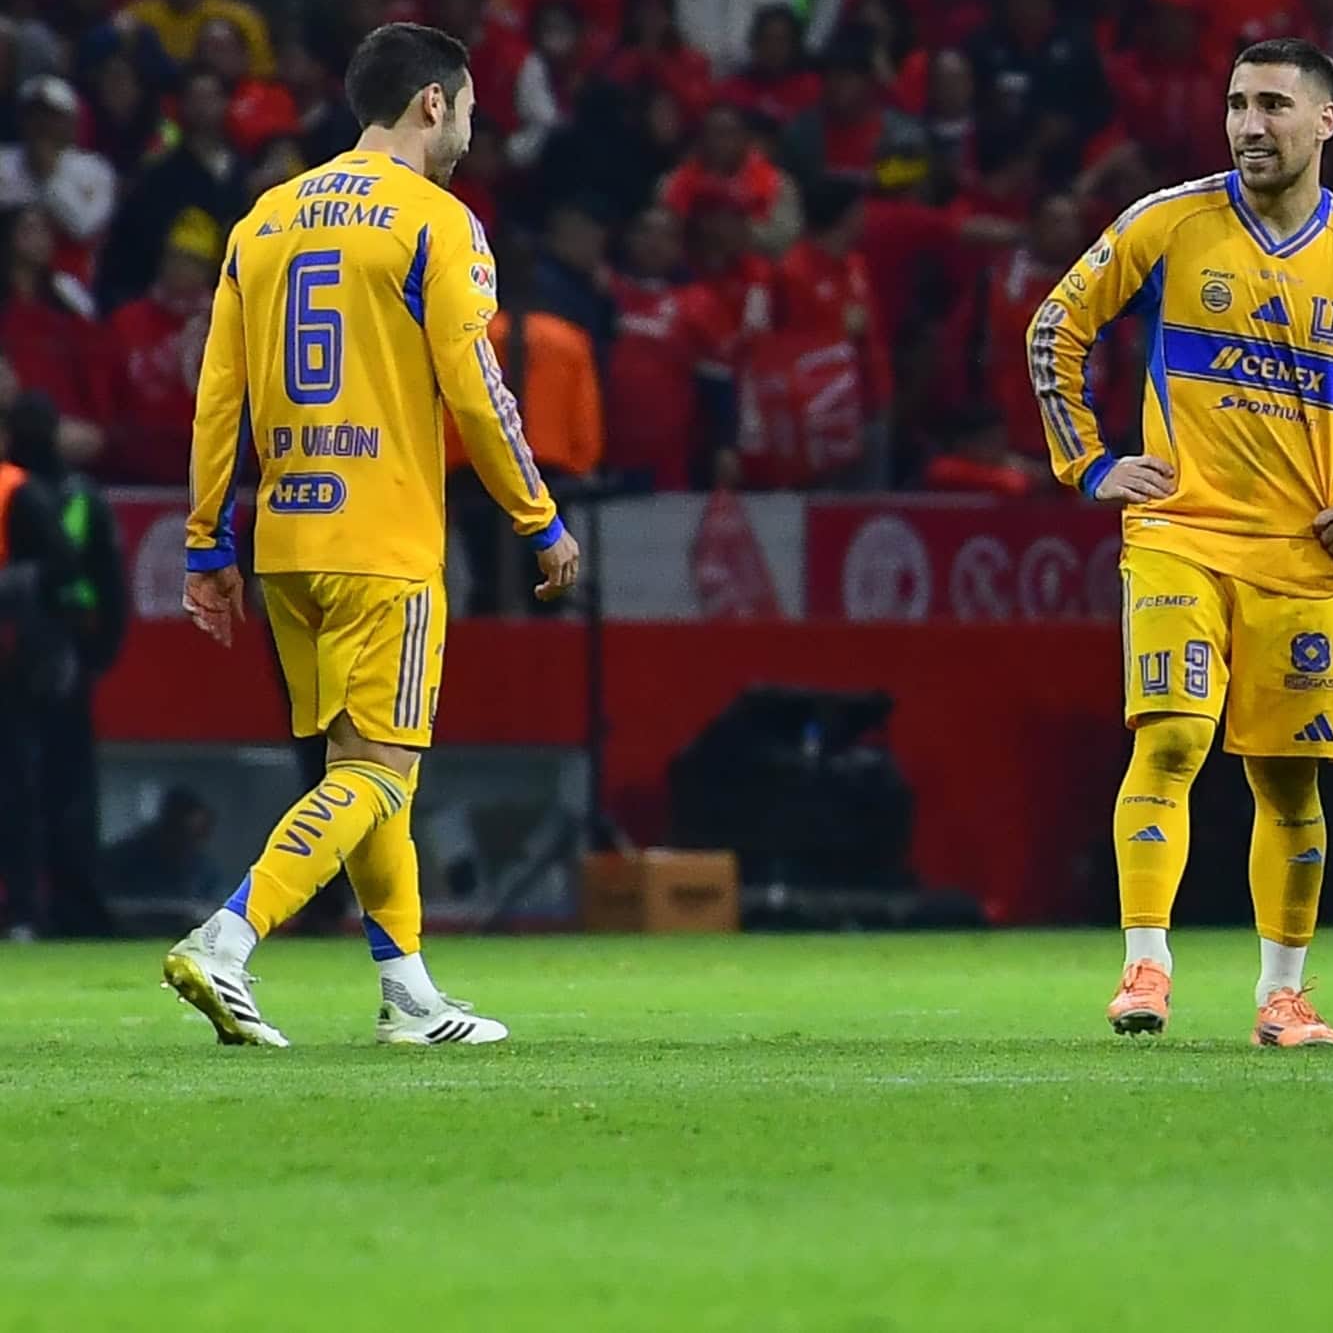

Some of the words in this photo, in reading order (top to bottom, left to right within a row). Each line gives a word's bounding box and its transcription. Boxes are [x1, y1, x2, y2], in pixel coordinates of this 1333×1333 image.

[289, 200, 400, 229] AFIRME
[285, 250, 342, 405] 6
[1241, 355, 1326, 393] CEMEX
[1185, 640, 1211, 699] 8
